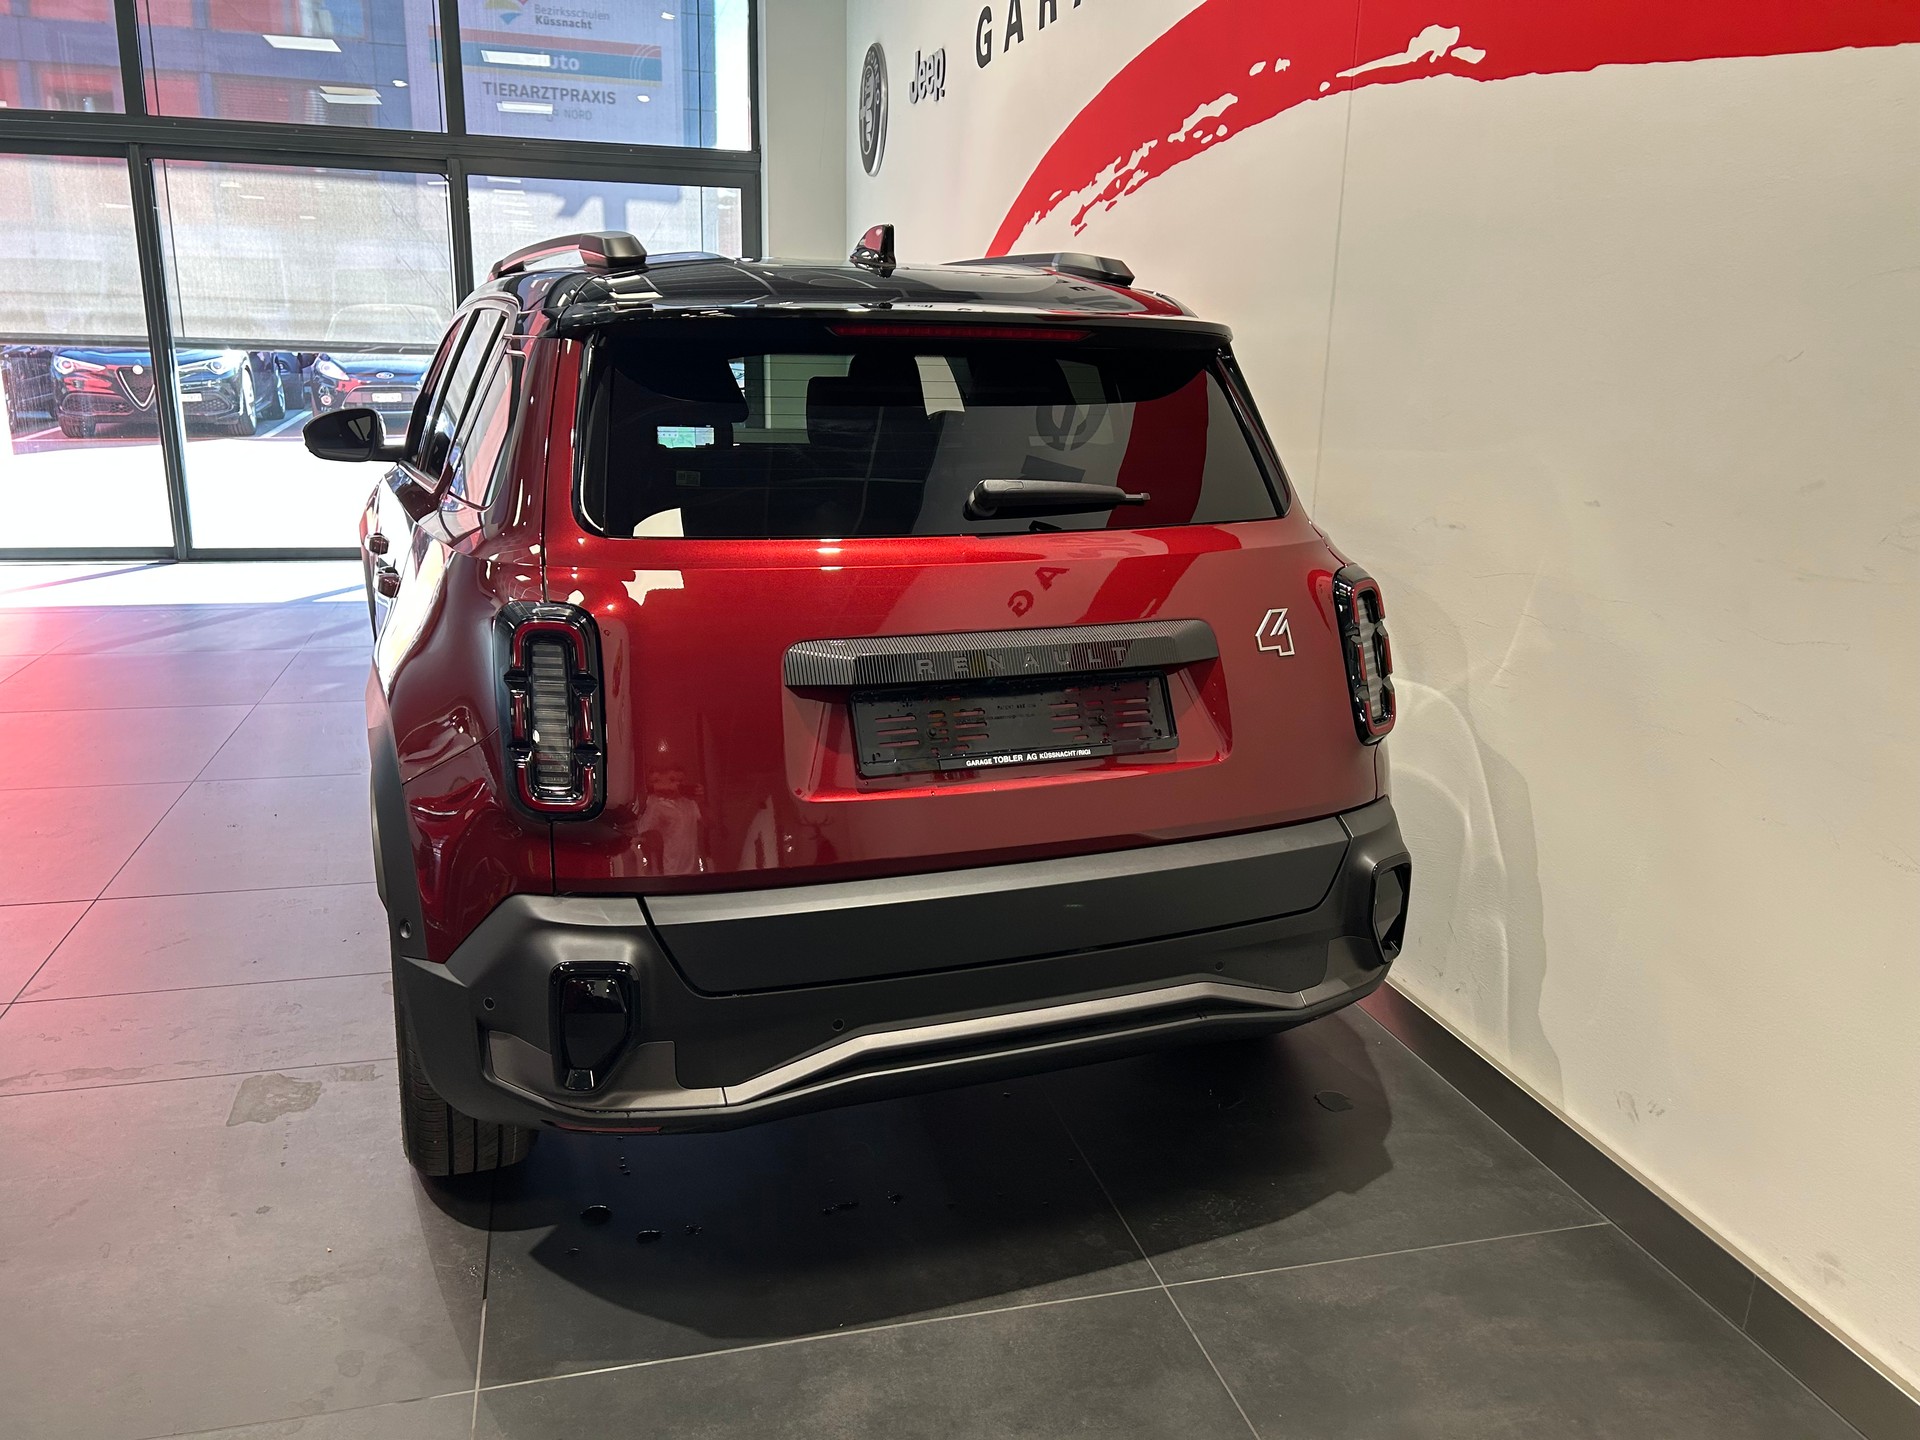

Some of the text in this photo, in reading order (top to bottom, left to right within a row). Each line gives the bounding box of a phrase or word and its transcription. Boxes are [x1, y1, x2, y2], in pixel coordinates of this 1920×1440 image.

[534, 4, 610, 20] Bezirksschulen
[535, 15, 592, 29] Küssnacht
[976, 0, 1081, 68] GA
[909, 48, 946, 104] Jeep
[482, 81, 616, 105] TIERARZTPRAXIS
[564, 109, 592, 121] NORD
[916, 646, 1127, 676] RENAULT
[966, 758, 992, 767] GARAGE
[993, 754, 1023, 764] TOBLER
[1026, 753, 1038, 761] AG
